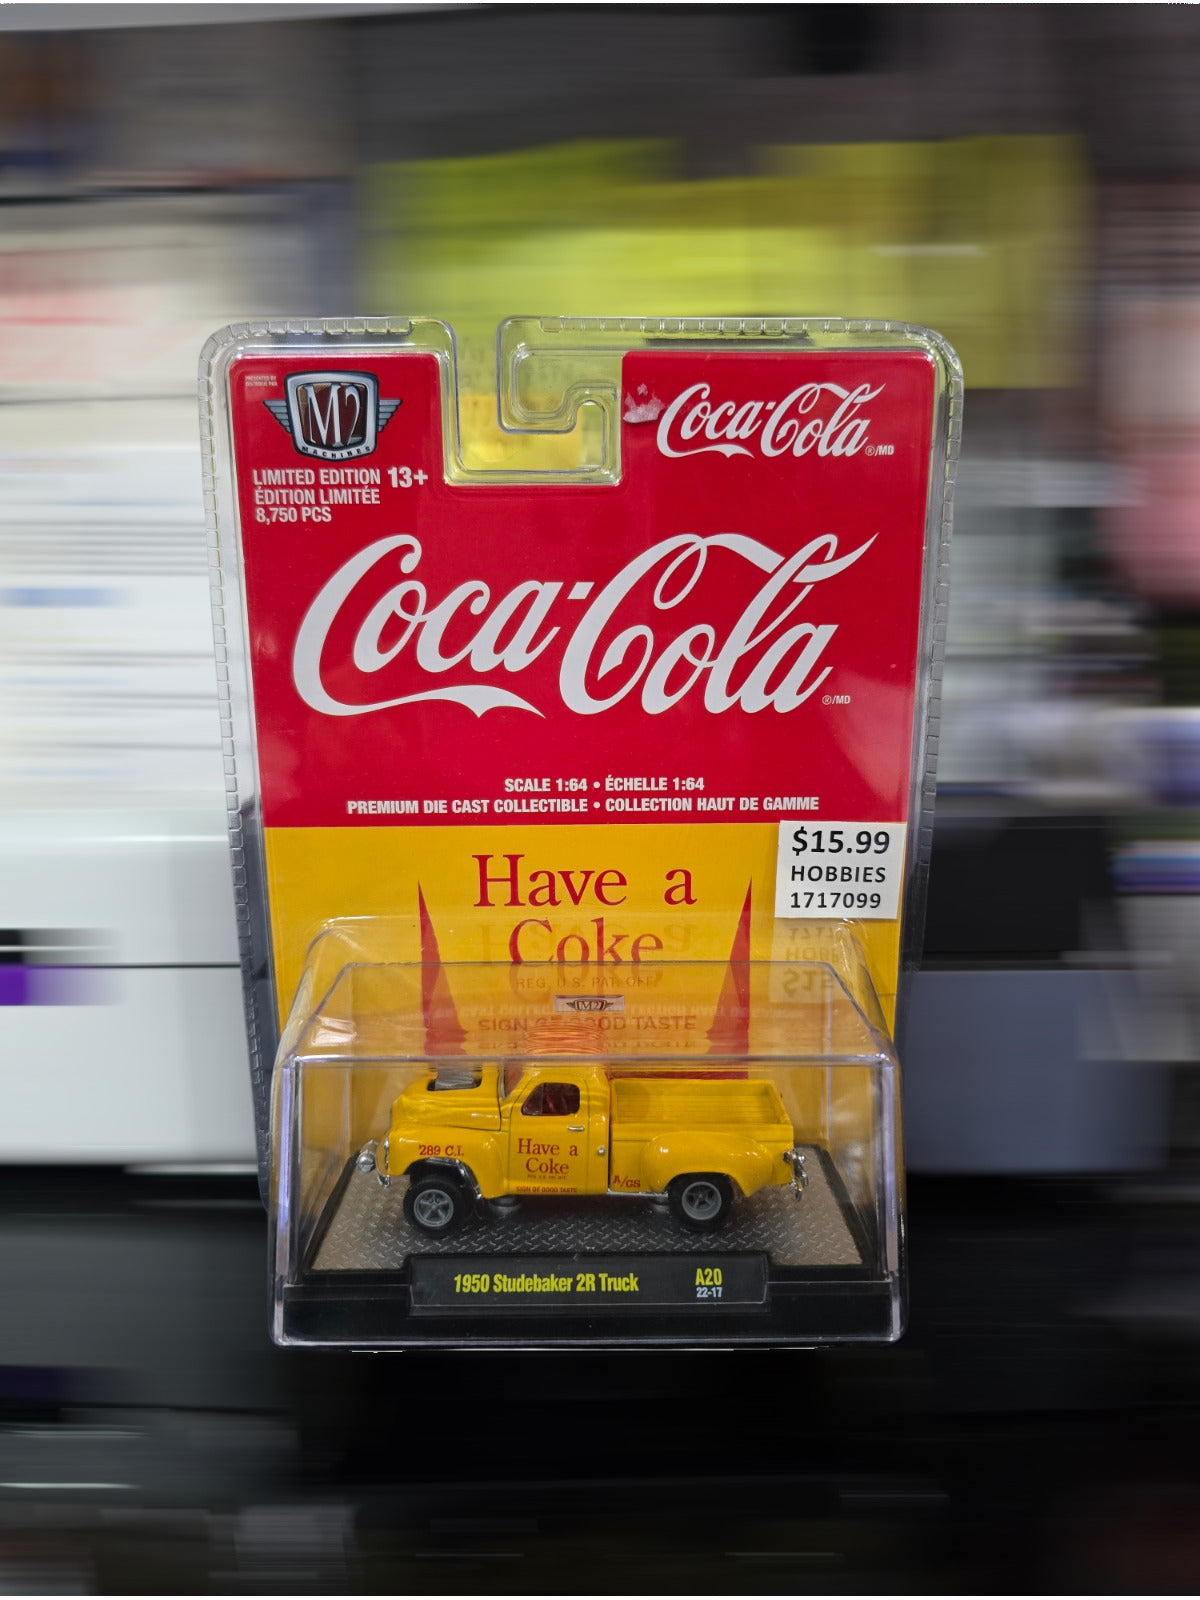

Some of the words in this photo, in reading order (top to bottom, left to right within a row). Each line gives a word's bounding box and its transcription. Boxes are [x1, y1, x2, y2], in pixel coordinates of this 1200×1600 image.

[303, 383, 363, 447] M2
[657, 383, 886, 458] Coca-Cola
[302, 446, 371, 458] MACHINES
[253, 469, 316, 485] LIMITED
[319, 469, 381, 485] EDITION
[387, 467, 428, 488] 13+
[255, 486, 316, 505] ÉDITION
[319, 485, 381, 504] LIMITÉE
[256, 507, 297, 525] 8,750
[301, 507, 332, 523] PCS
[292, 532, 879, 718] Coca-Cola
[504, 778, 551, 792] SCALE
[556, 778, 588, 791] 1:64
[605, 775, 668, 791] ÉCHELLE
[672, 777, 705, 791] 1:64
[347, 800, 419, 814] PREMIUM
[423, 800, 448, 813] DIE
[452, 800, 490, 813] CAST
[494, 799, 588, 812] COLLECTIBLE
[605, 798, 692, 811] COLLECTION
[697, 798, 735, 811] HAUT
[739, 797, 759, 810] DE
[763, 797, 820, 810] GAMME
[792, 826, 890, 856] $15.99
[471, 854, 628, 907] Have
[664, 867, 698, 905] a
[791, 865, 886, 883] HOBBIES
[790, 892, 881, 908] 1717099
[508, 917, 664, 964] Coke
[478, 1018, 527, 1031] SIGN
[632, 1015, 697, 1030] TASTE
[419, 1144, 441, 1156] 289
[517, 1138, 560, 1156] Have
[569, 1144, 578, 1156] a
[525, 1158, 569, 1174] Coke
[454, 1274, 489, 1293] 1950
[493, 1273, 573, 1293] Studebaker
[576, 1273, 595, 1292] 2R
[599, 1272, 639, 1292] Truck
[695, 1268, 722, 1286] A20
[696, 1287, 722, 1298] 22-17
